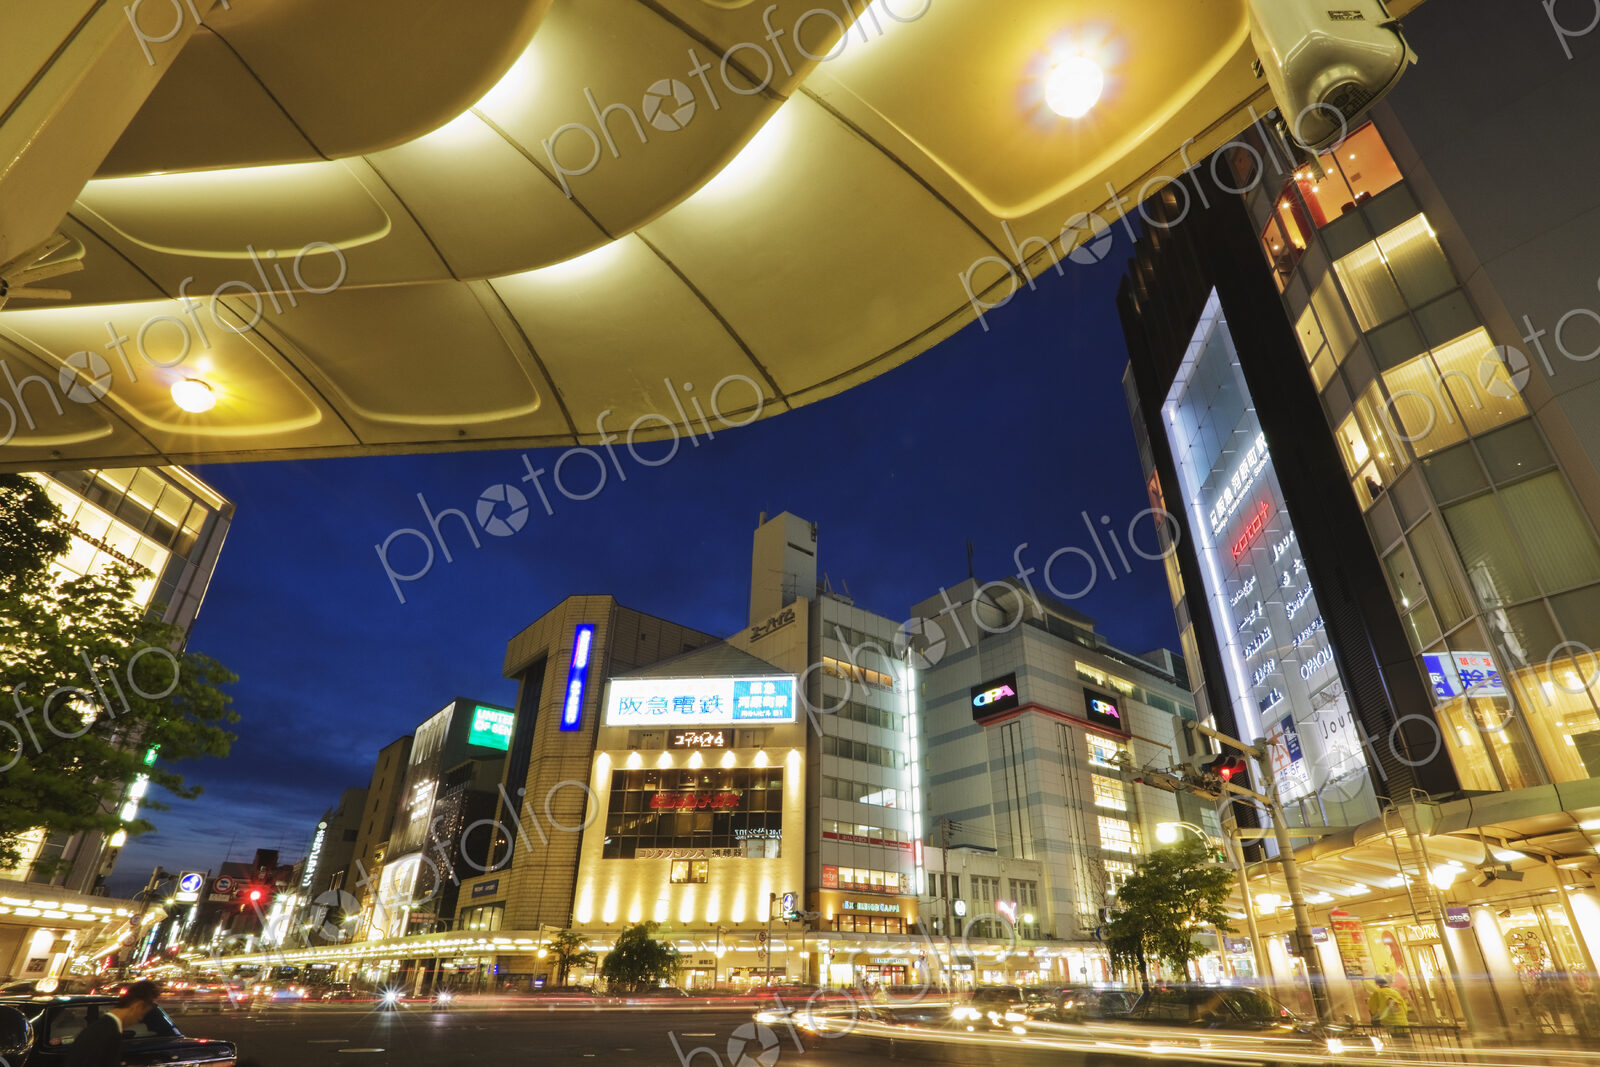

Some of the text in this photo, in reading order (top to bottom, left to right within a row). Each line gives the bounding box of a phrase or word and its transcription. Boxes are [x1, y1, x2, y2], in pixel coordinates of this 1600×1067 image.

[618, 694, 724, 716] 阪急電鉄
[973, 684, 1015, 707] OPA
[1091, 699, 1120, 719] OPA
